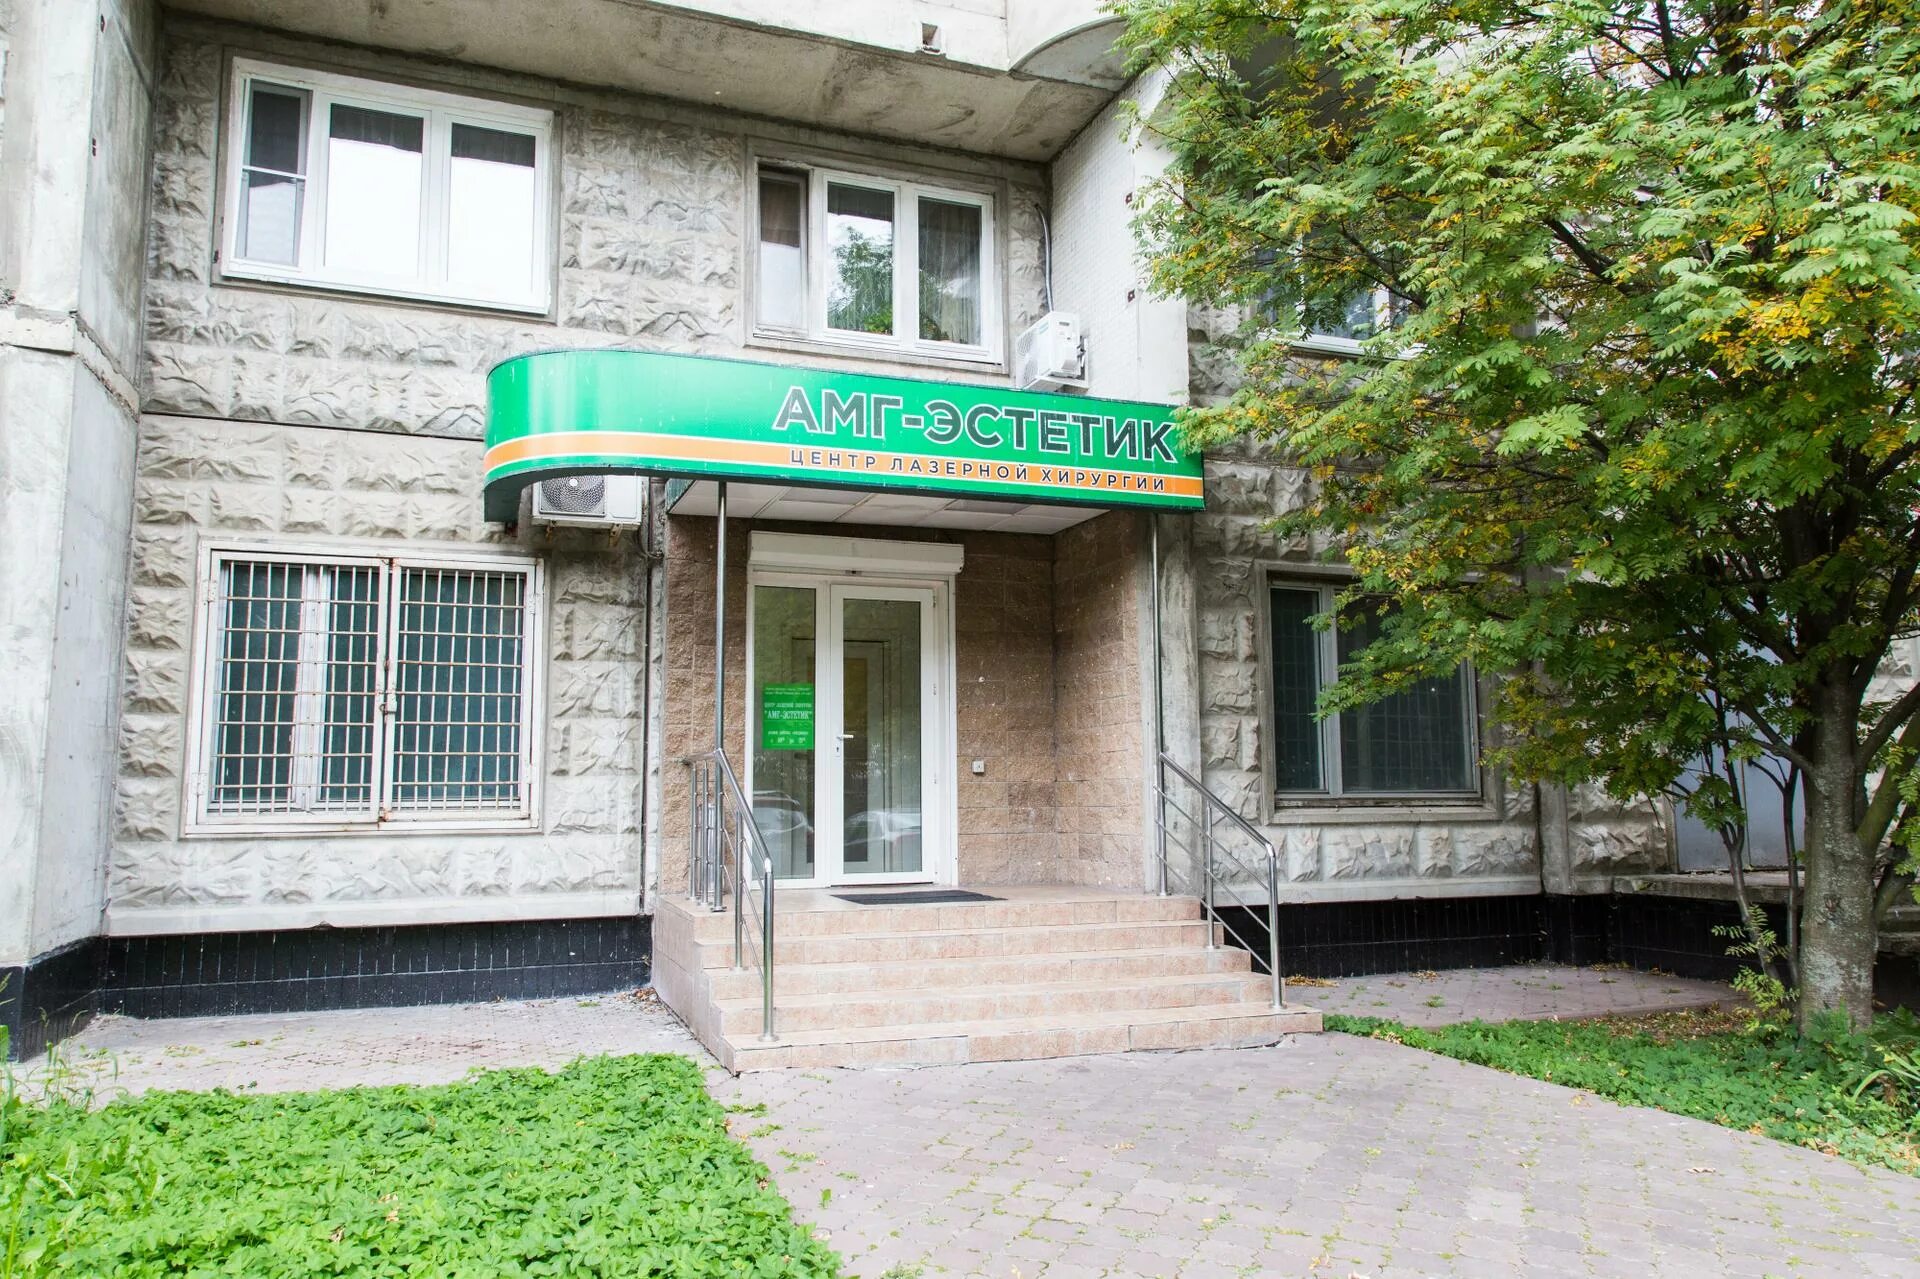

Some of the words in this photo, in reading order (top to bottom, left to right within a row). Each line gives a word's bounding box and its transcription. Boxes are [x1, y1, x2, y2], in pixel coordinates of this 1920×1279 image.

[772, 386, 1178, 463] АМГ-ЭСТЕТИК
[791, 449, 876, 469] ЦЕНТР
[890, 457, 1028, 480] ЛАЗЕРНОЙ
[1041, 468, 1165, 491] ХИРУРГИИ
